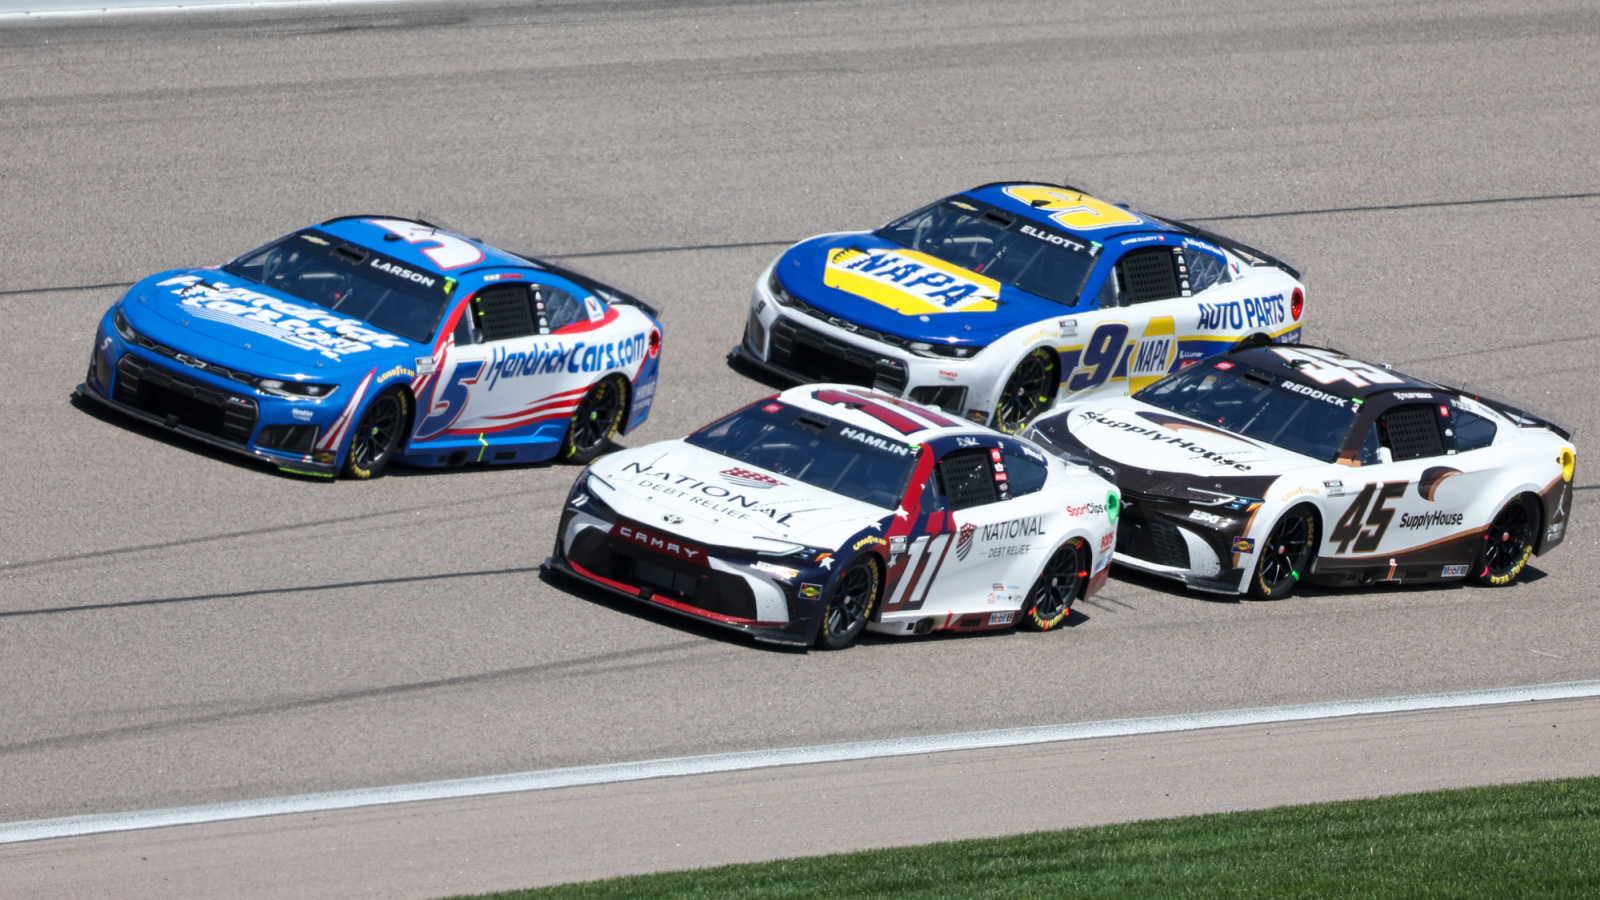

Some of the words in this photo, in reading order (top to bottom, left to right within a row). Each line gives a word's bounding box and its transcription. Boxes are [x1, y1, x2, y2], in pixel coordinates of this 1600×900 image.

[1020, 224, 1085, 253] ELLIOTT
[370, 258, 436, 288] LARSON
[846, 251, 981, 308] NAPA
[1197, 302, 1243, 330] AUTO
[1245, 293, 1285, 327] PARTS
[100, 336, 113, 350] 5
[1065, 320, 1131, 394] 9
[1133, 337, 1171, 374] NAPA
[376, 365, 416, 383] GOODYEAR
[485, 331, 645, 395] HendrickCars.com
[413, 358, 487, 442] 5
[1281, 380, 1349, 408] REDDICK
[840, 427, 910, 457] HAMLIN
[621, 462, 794, 528] NATIONAL
[638, 479, 689, 499] DEBT
[690, 495, 752, 521] RELIEF
[981, 516, 1047, 542] NATIONAL
[1329, 479, 1410, 555] 45
[1400, 510, 1464, 531] SupplyHouse
[619, 526, 700, 559] CAMRY
[852, 535, 887, 551] GOODYEAR
[987, 547, 1006, 558] DEBT
[1006, 544, 1032, 557] RELIEF
[885, 532, 954, 607] 11
[1443, 566, 1460, 575] Mobil
[991, 613, 1007, 623] Mobil
